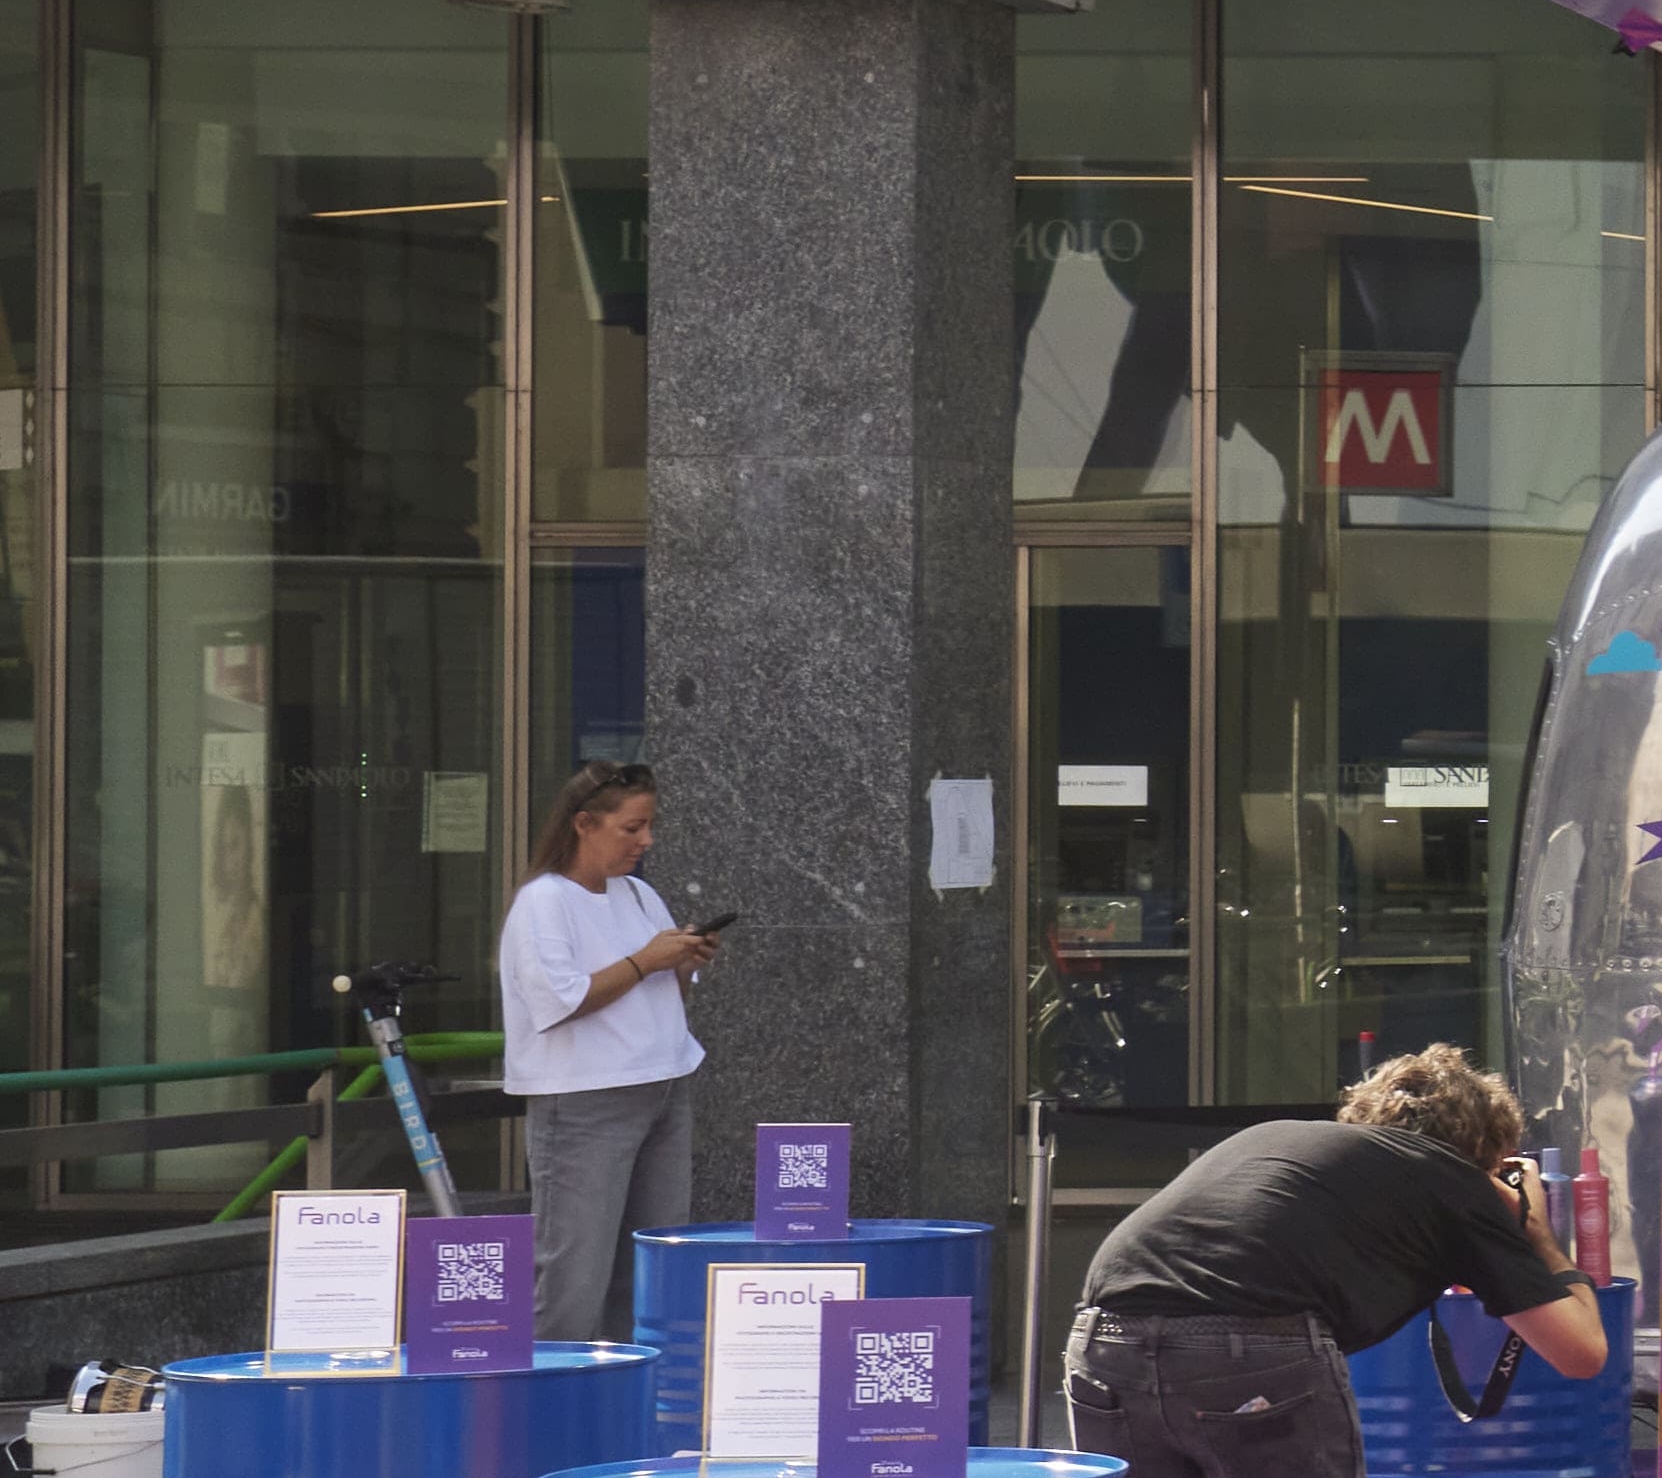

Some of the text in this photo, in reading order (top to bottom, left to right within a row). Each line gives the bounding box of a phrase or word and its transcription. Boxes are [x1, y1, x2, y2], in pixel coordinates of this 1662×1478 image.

[391, 1080, 428, 1151] BIRD
[297, 1206, 382, 1226] Fanola
[737, 1281, 836, 1306] Fanola
